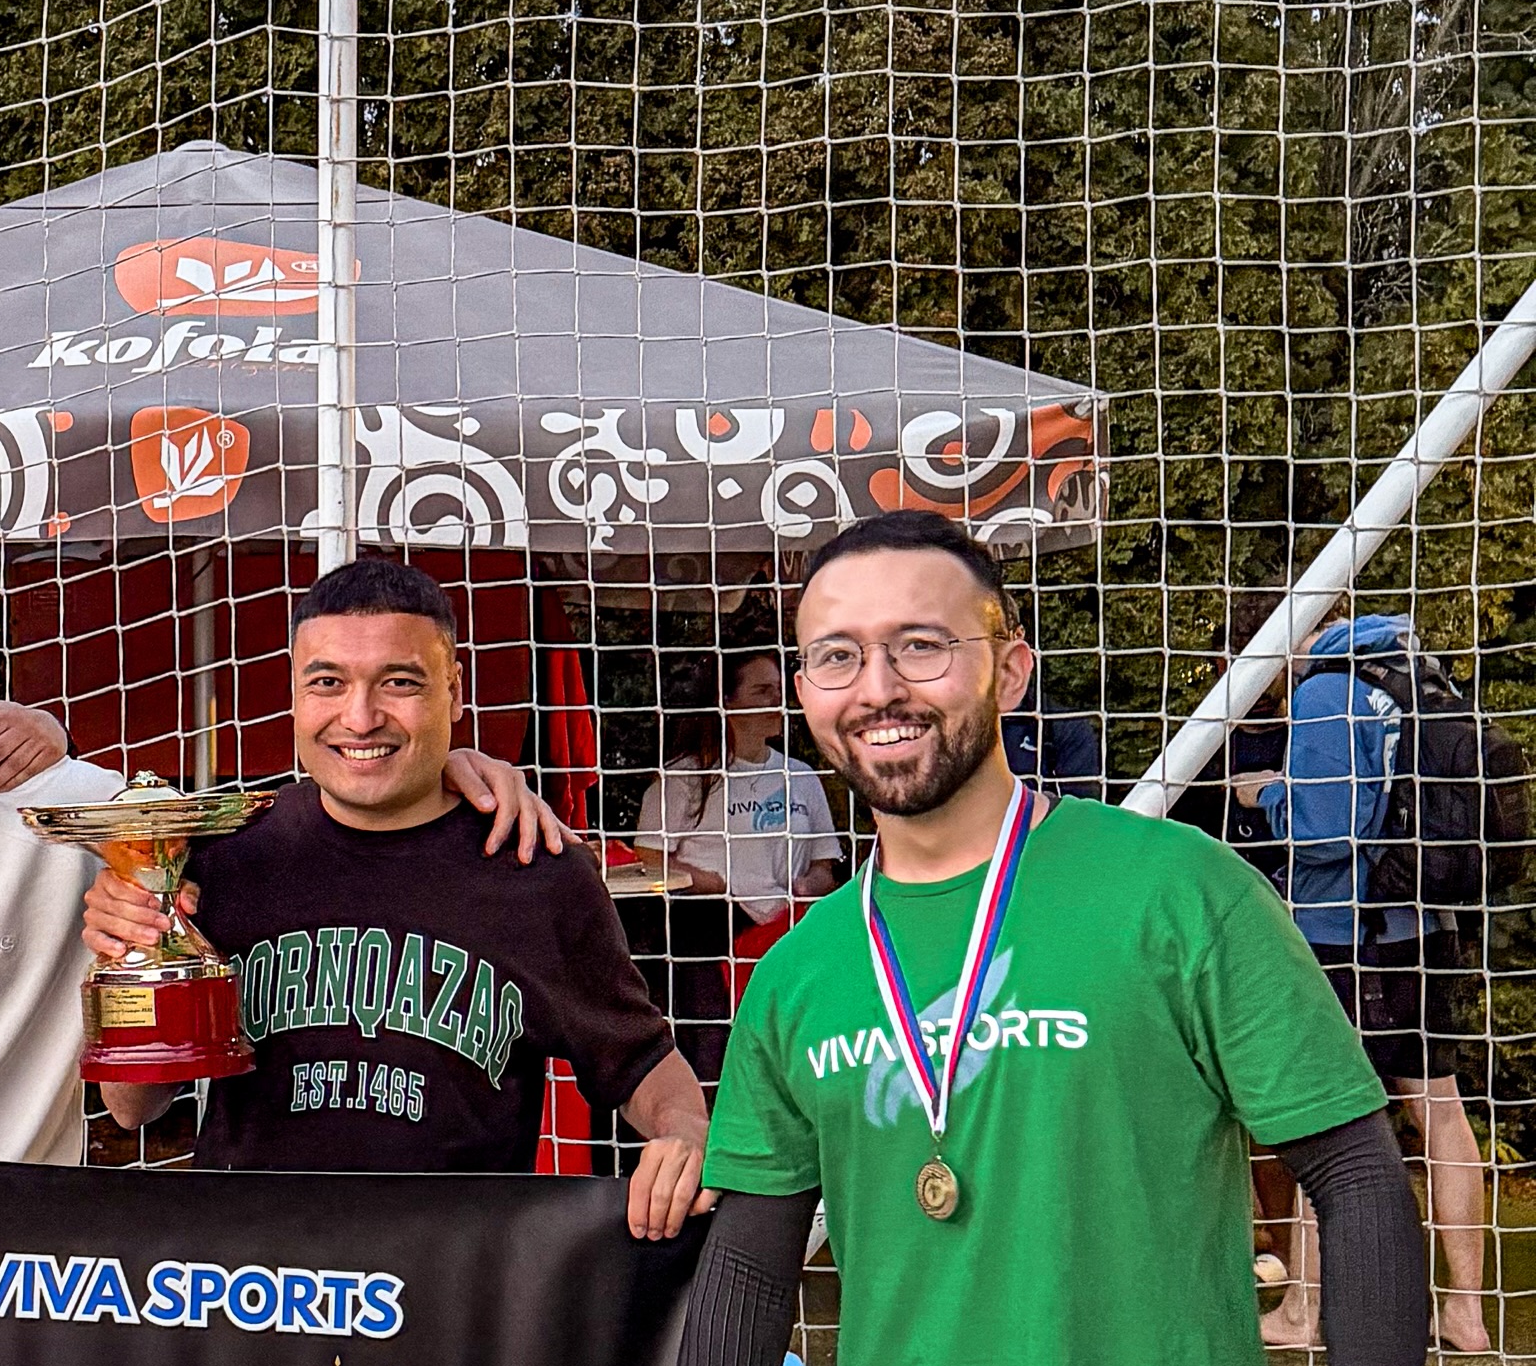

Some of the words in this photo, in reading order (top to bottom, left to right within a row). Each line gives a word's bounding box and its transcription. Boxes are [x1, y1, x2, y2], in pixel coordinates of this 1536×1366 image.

[728, 800, 763, 816] VIVA
[807, 1027, 897, 1079] VIVA
[291, 1061, 425, 1122] EST.1465
[143, 1260, 406, 1340] SPORTS
